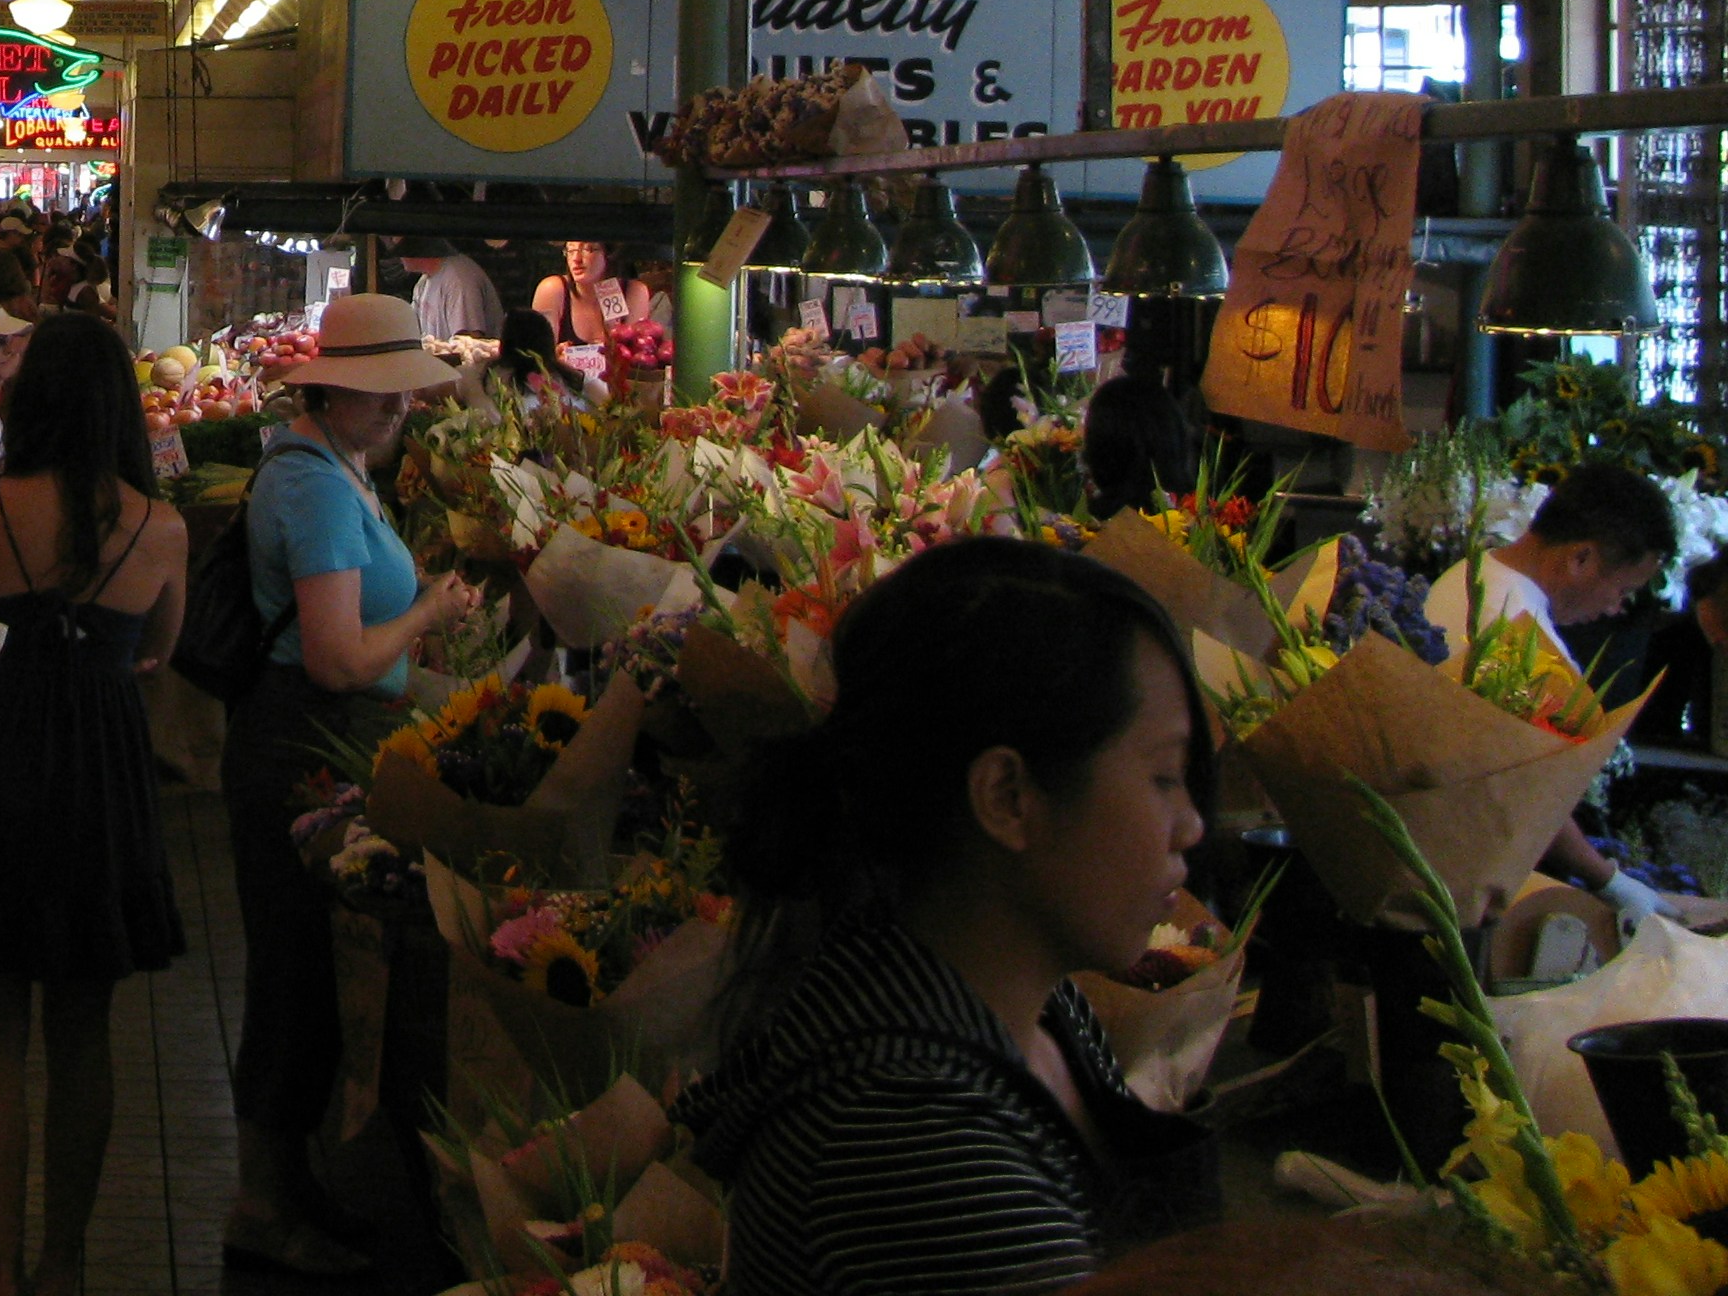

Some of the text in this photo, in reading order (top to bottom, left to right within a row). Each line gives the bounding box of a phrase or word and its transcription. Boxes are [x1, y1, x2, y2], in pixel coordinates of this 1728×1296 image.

[428, 35, 592, 78] PICKED
[448, 80, 574, 120] DAILY
[974, 60, 1012, 104] &
[1116, 103, 1162, 129] TO
[1186, 96, 1263, 126] YOU
[602, 295, 623, 319] 98
